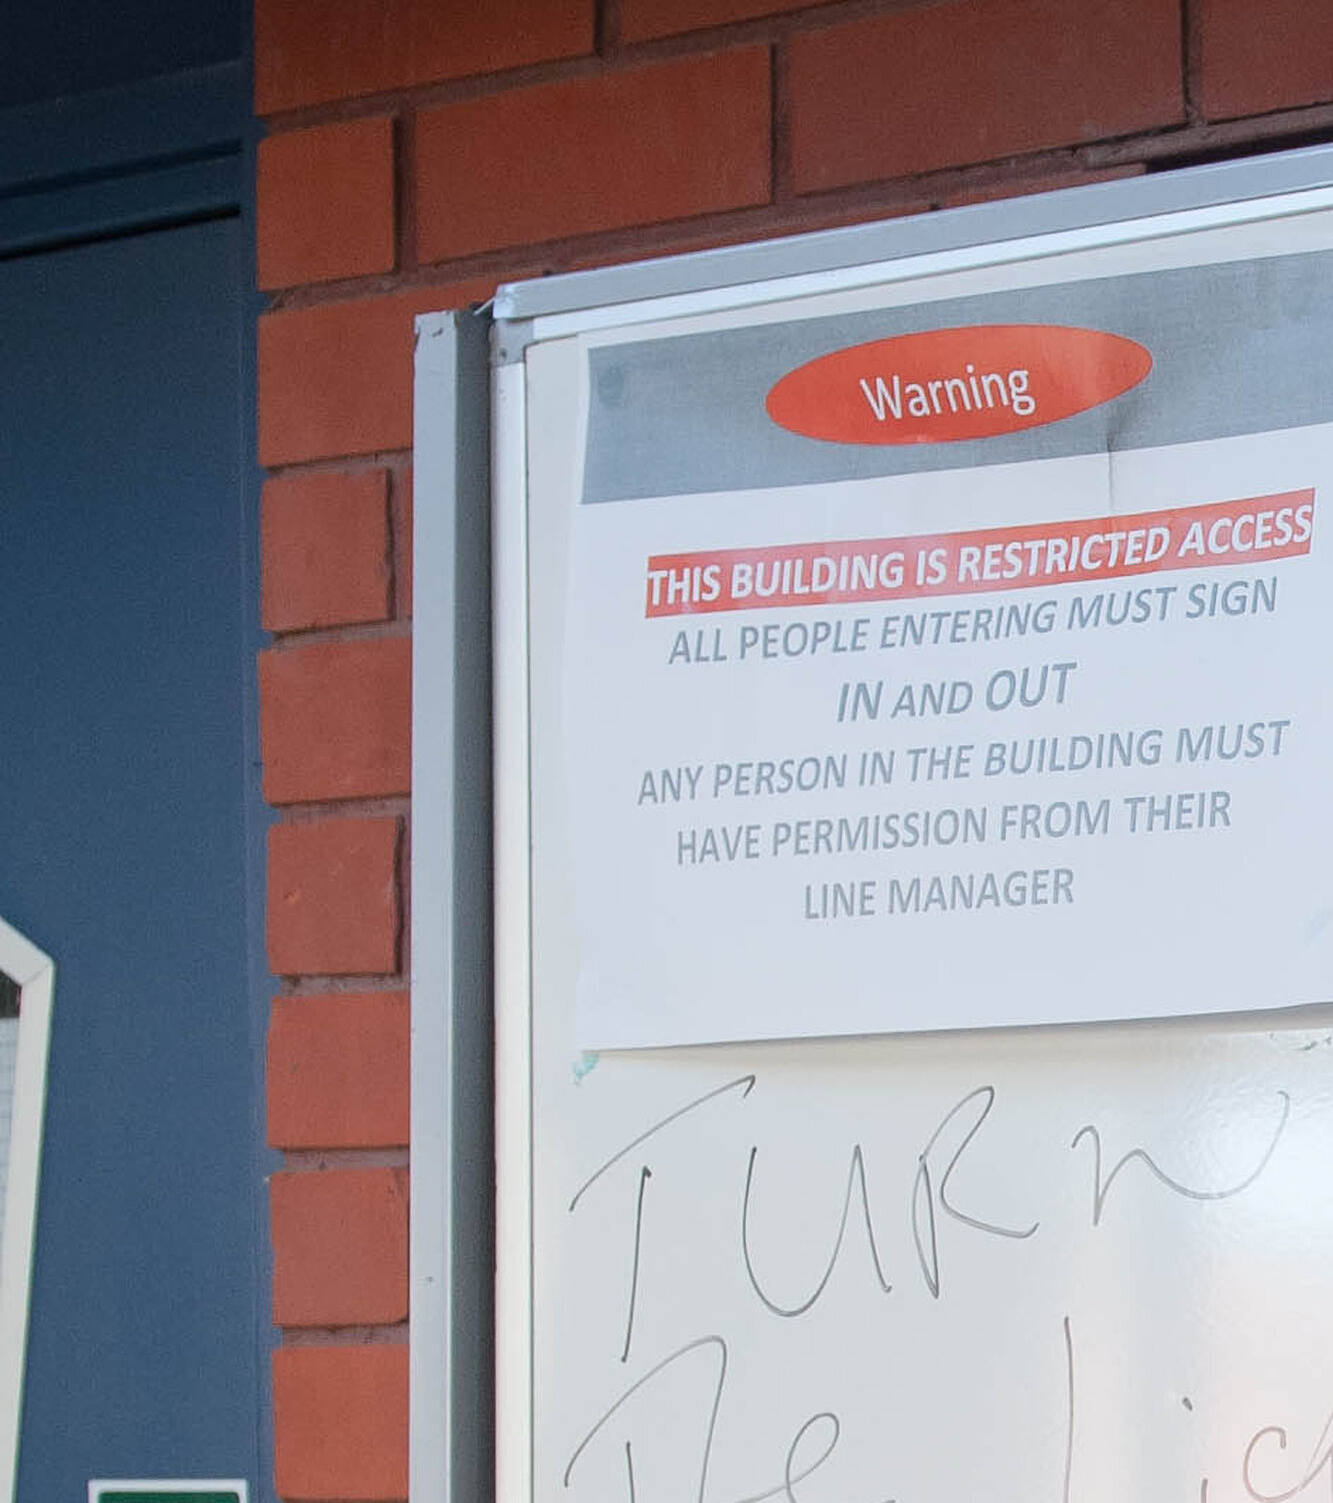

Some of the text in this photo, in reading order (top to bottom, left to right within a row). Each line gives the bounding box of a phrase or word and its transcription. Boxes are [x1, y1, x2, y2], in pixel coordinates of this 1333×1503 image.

[859, 364, 1036, 423] Warning
[648, 504, 1314, 607] THIS BUILDING IS RESTRICTED ACCESS
[668, 576, 1279, 666] ALL PEOPLE ENTERING MUST SIGN
[836, 662, 1078, 723] IN AND OUT
[637, 719, 1291, 806] ANY PERSON IN THE BUILDING MUST
[677, 790, 1233, 865] HAVE PERMISSION FROM THEIR
[803, 868, 1076, 921] LINE MANAGER
